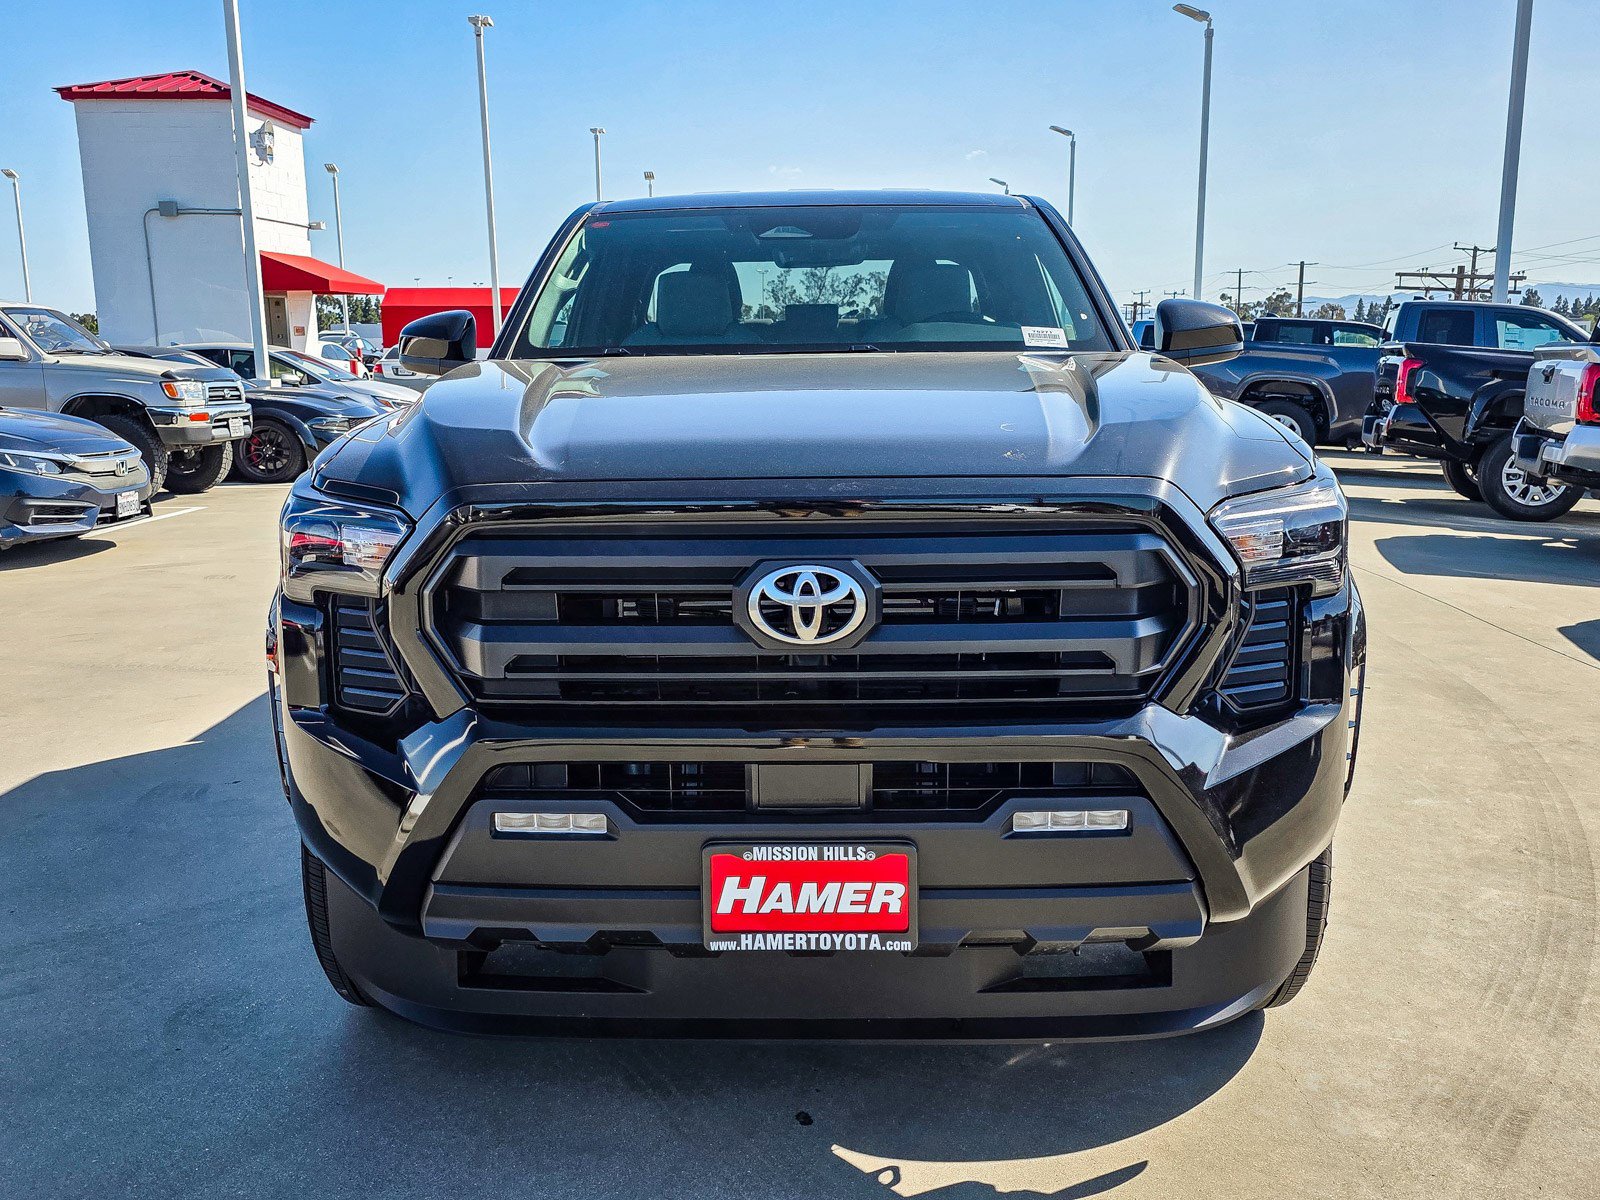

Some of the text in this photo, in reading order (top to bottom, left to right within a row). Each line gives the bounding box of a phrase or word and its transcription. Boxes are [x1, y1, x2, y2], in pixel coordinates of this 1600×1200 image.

[1530, 397, 1565, 409] TACOMA
[753, 847, 866, 861] MISSION HILLS
[716, 876, 905, 914] HAMER
[710, 933, 912, 951] www.HAMERTOYOTA.com
